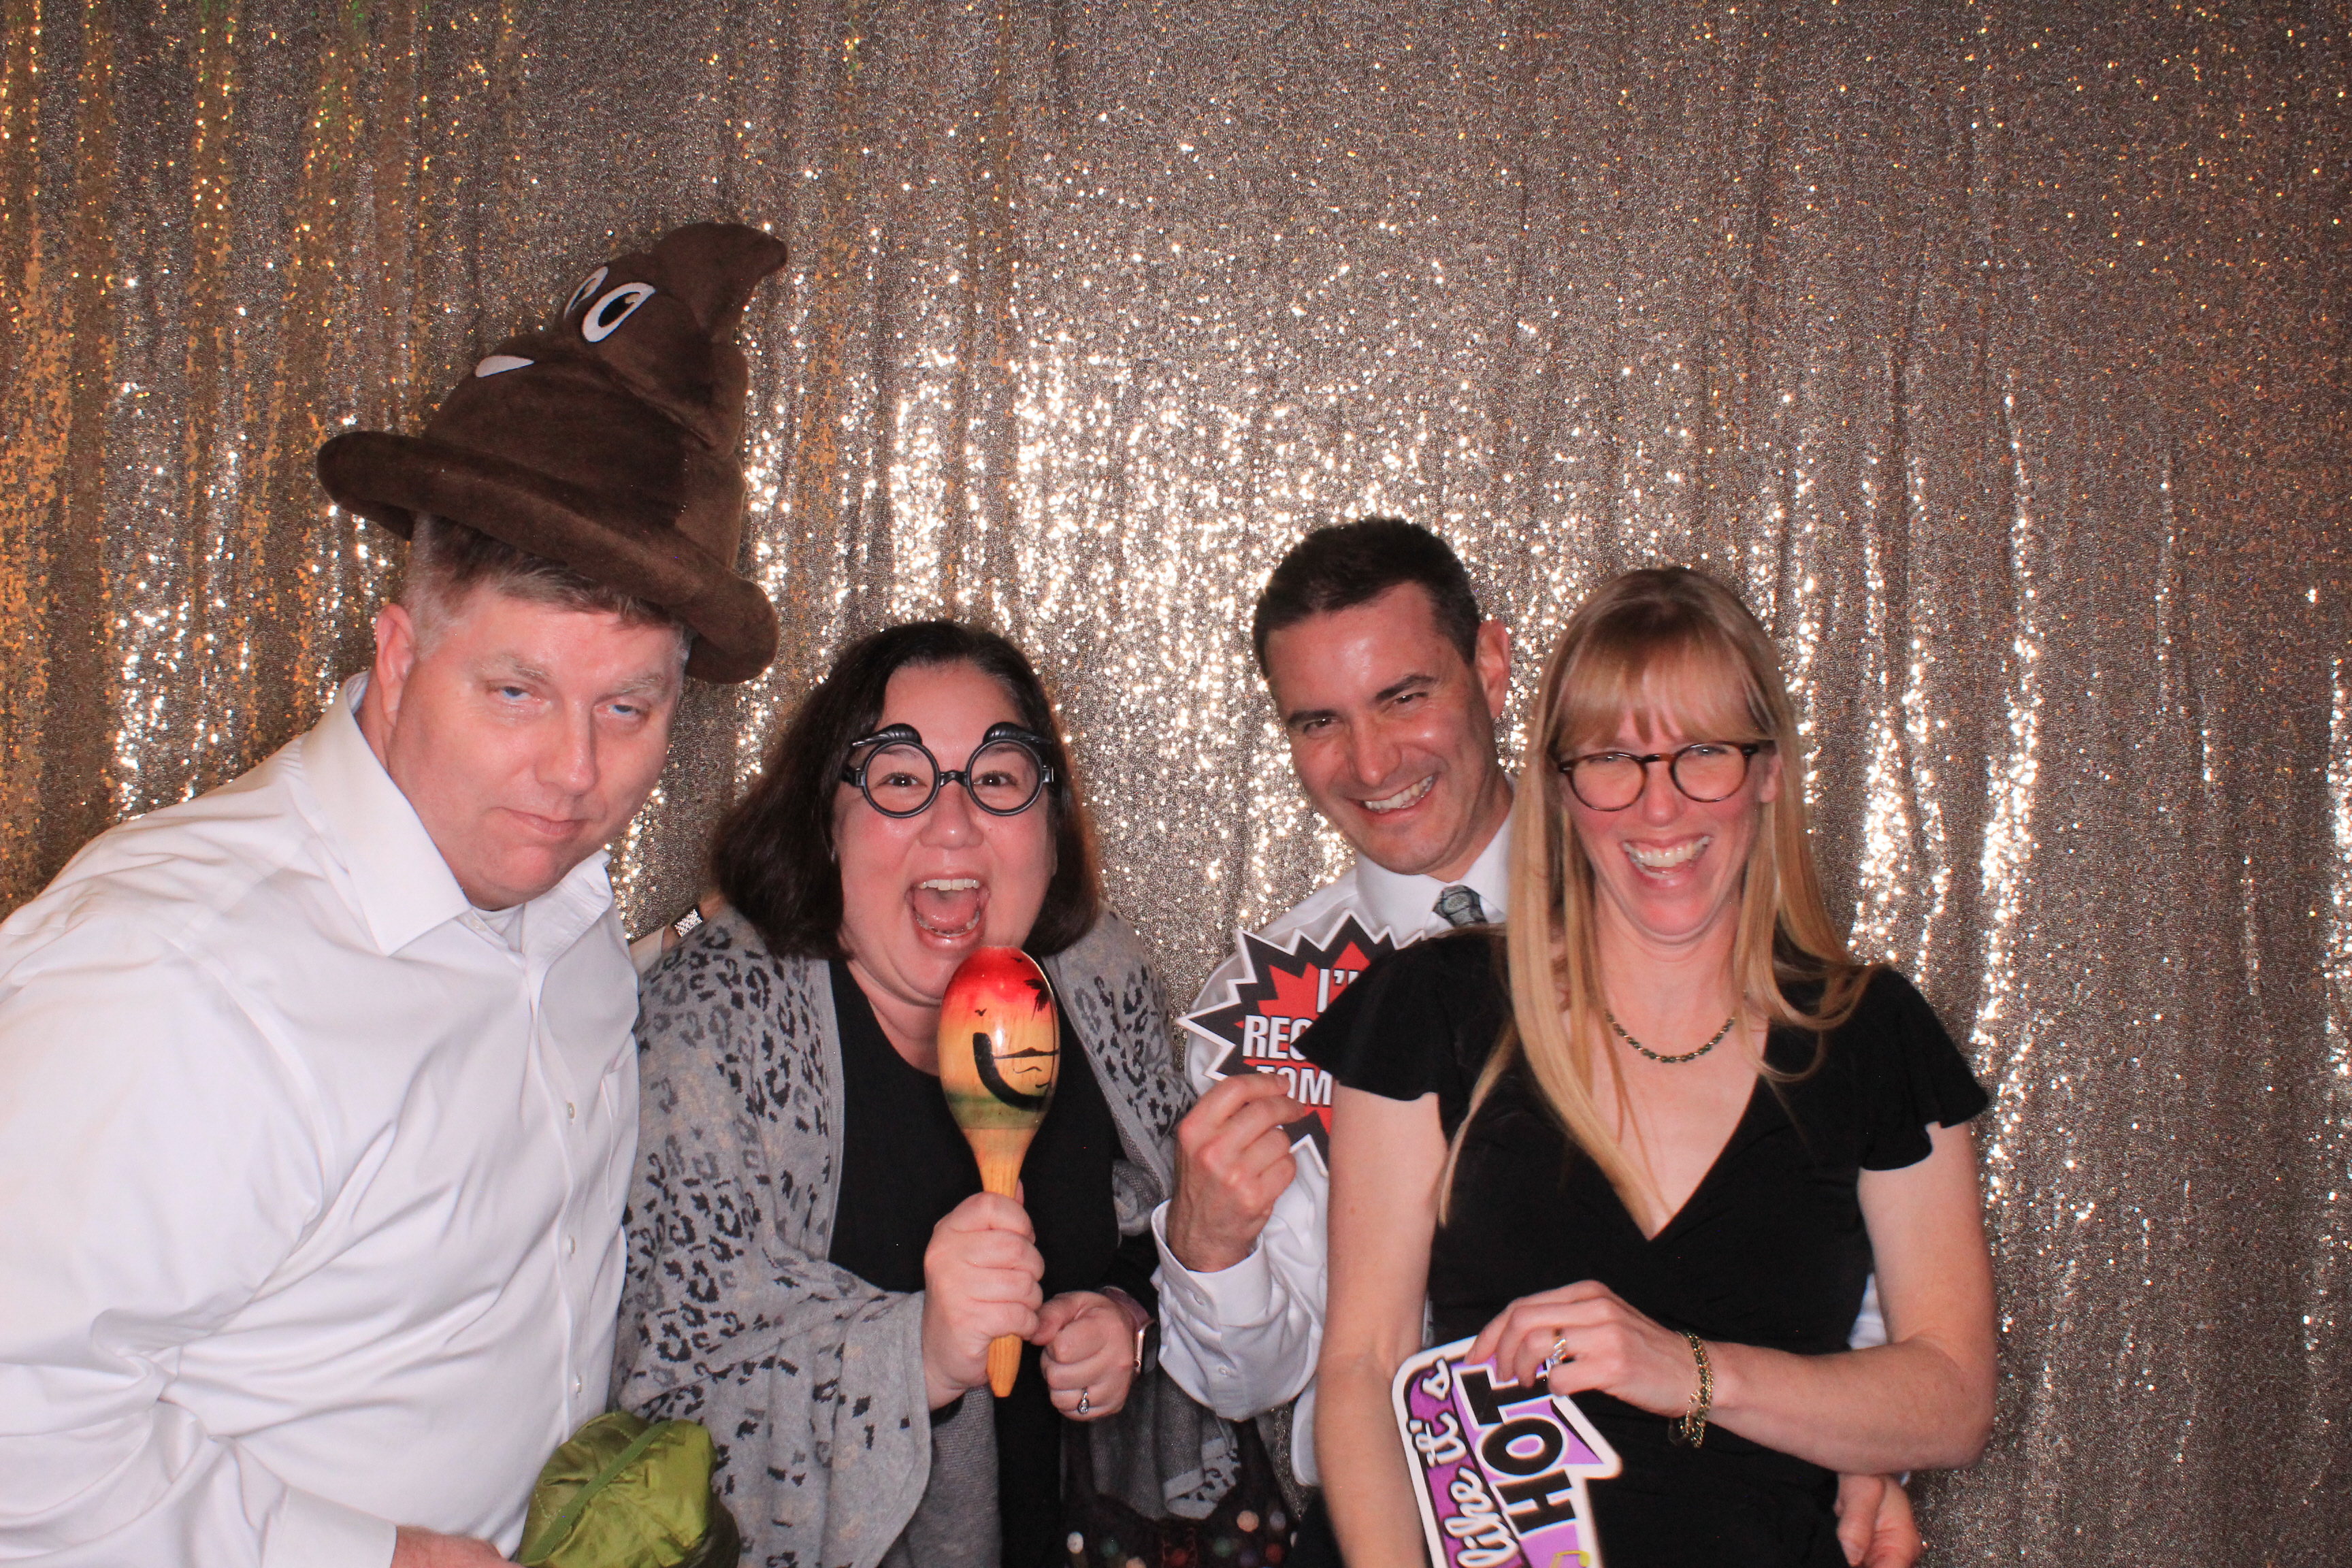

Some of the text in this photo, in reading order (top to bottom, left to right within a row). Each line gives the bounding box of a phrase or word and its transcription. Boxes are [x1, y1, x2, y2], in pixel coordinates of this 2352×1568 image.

[1316, 968, 1359, 1013] I'
[1456, 1365, 1578, 1537] HOT
[1444, 1467, 1519, 1568] like
